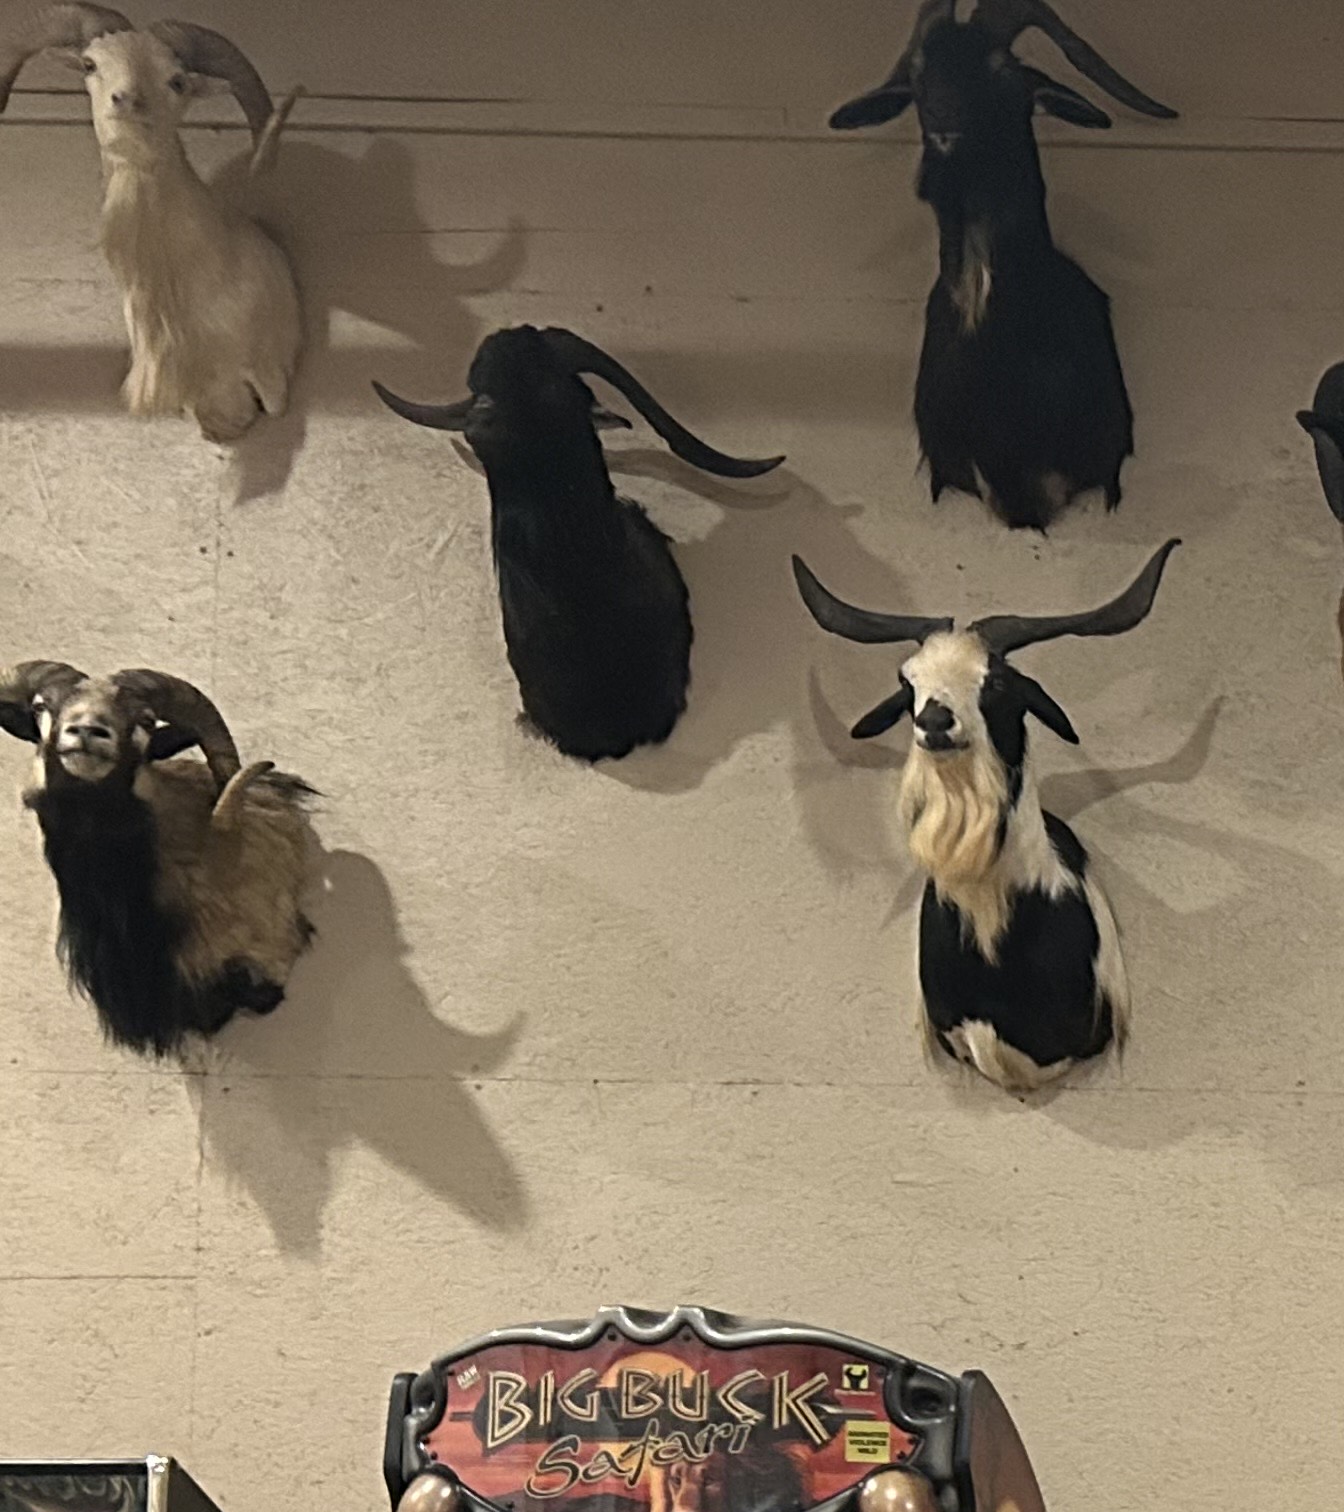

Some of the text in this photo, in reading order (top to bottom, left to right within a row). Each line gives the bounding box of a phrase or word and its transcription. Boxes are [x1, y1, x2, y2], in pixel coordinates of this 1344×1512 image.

[487, 1367, 833, 1449] BIG BUCK
[524, 1418, 752, 1499] Safari
